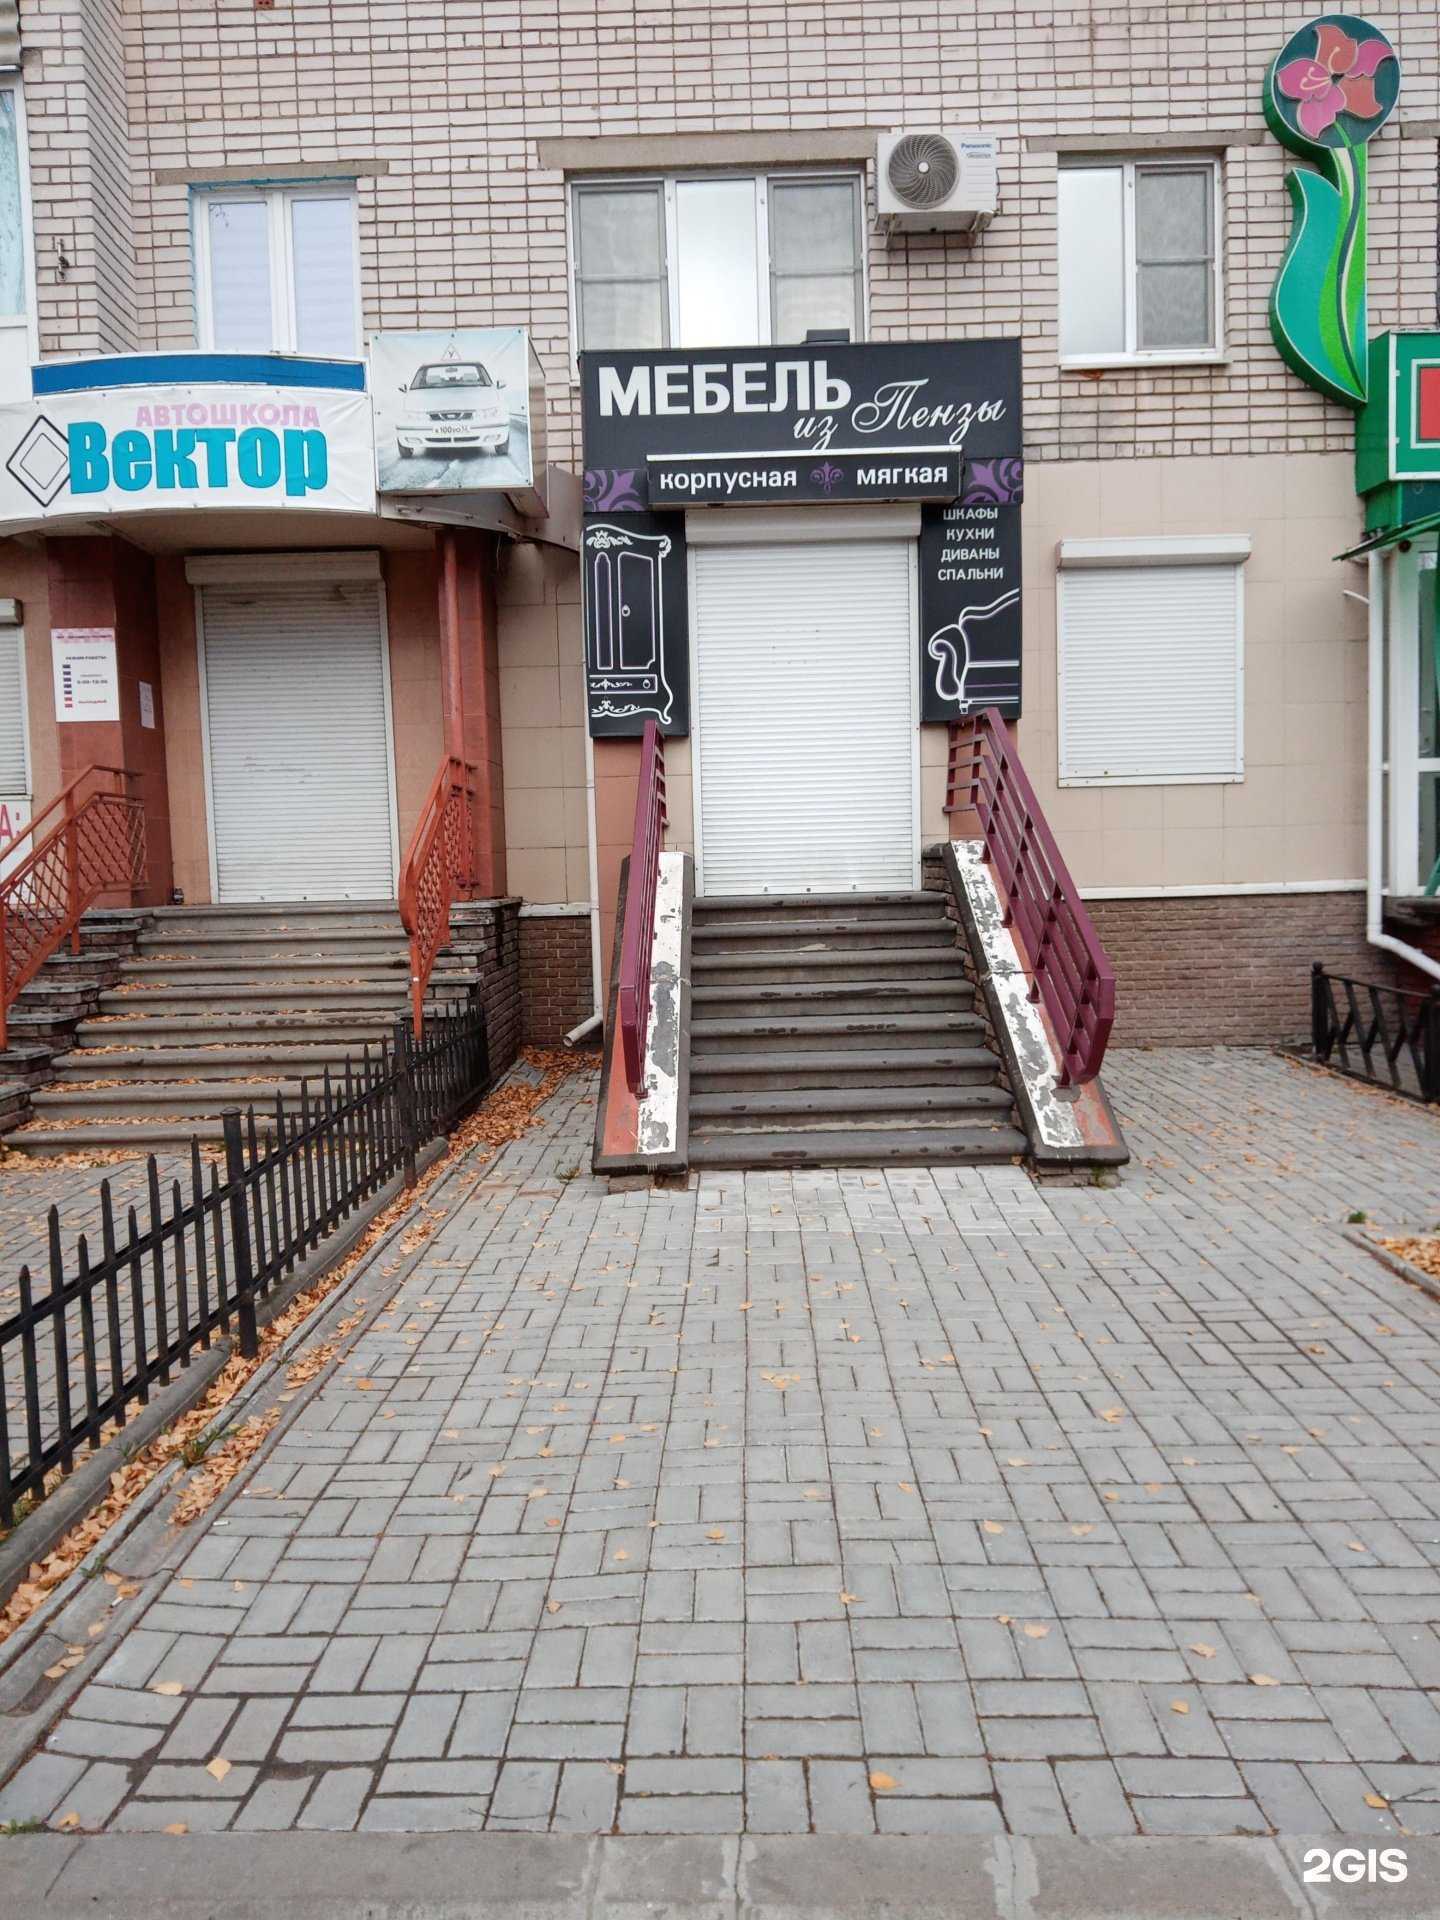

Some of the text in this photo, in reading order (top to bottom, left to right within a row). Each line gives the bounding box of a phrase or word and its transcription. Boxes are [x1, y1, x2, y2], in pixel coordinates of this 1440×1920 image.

[598, 360, 851, 416] МЕБЕЛЬ
[136, 403, 320, 428] АВТОШКОЛА
[793, 378, 1006, 451] из Пензы
[68, 421, 328, 496] Вектор
[660, 466, 948, 495] корпусная мягкая
[943, 507, 999, 520] ШКАФЫ
[946, 527, 995, 542] КУХНИ
[941, 547, 1000, 563] ДИВАНЫ
[937, 567, 1004, 581] СПАЛЬНИ
